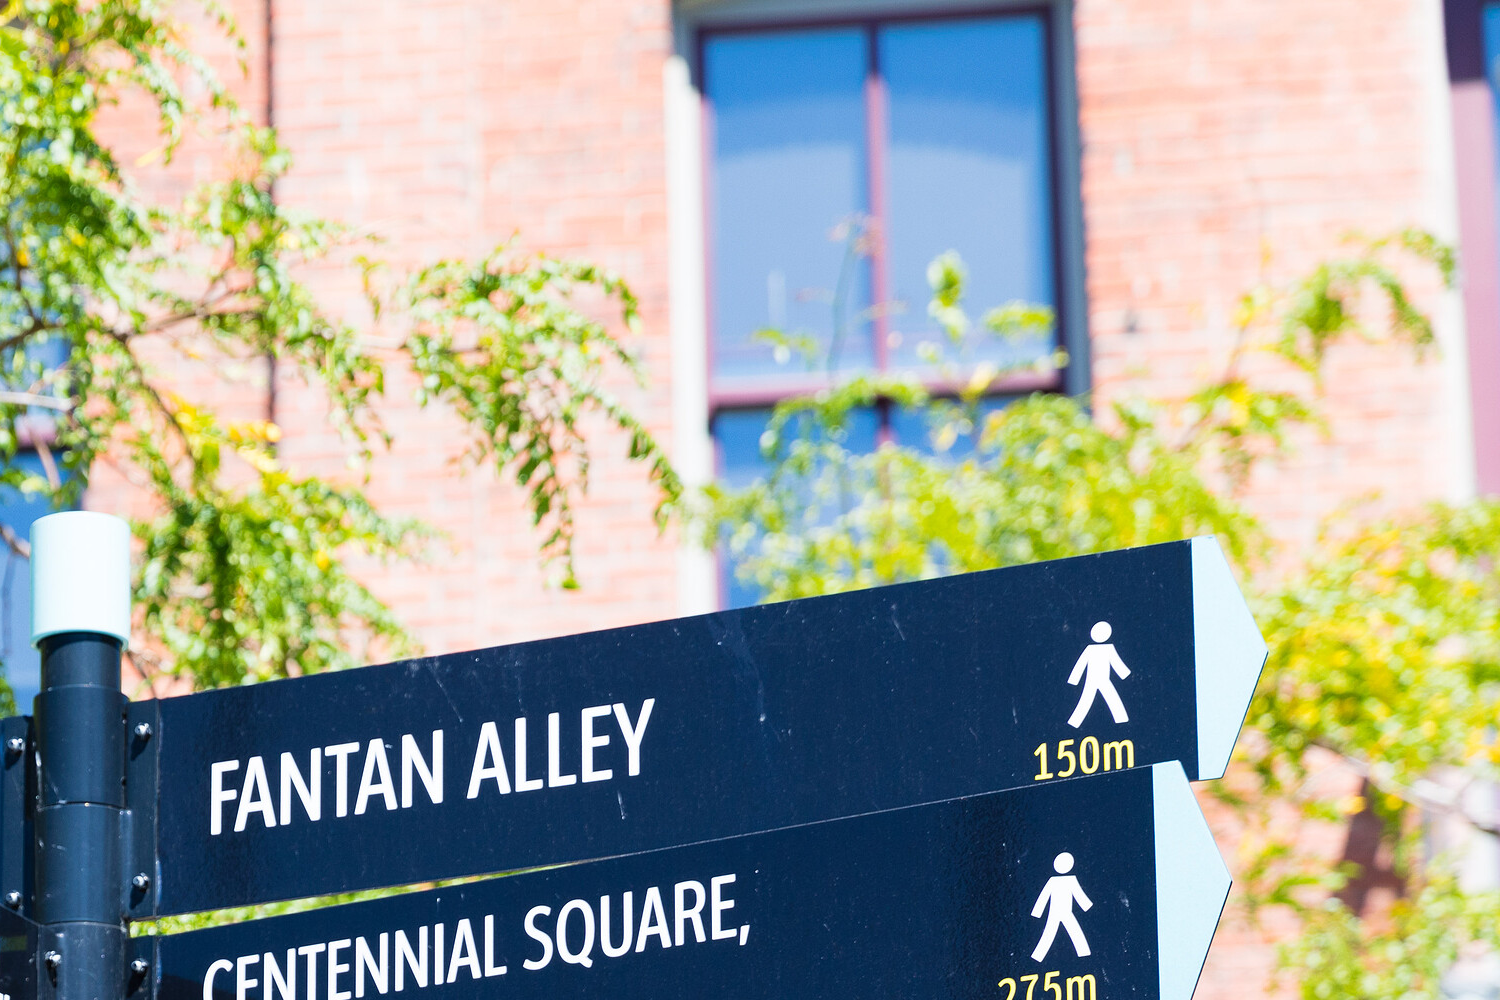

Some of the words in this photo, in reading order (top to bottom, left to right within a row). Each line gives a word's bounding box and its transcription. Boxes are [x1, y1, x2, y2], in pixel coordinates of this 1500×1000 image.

[211, 730, 443, 835] FANTAN
[467, 698, 655, 799] ALLEY
[1034, 736, 1134, 780] 150m
[523, 874, 750, 970] SQUARE,
